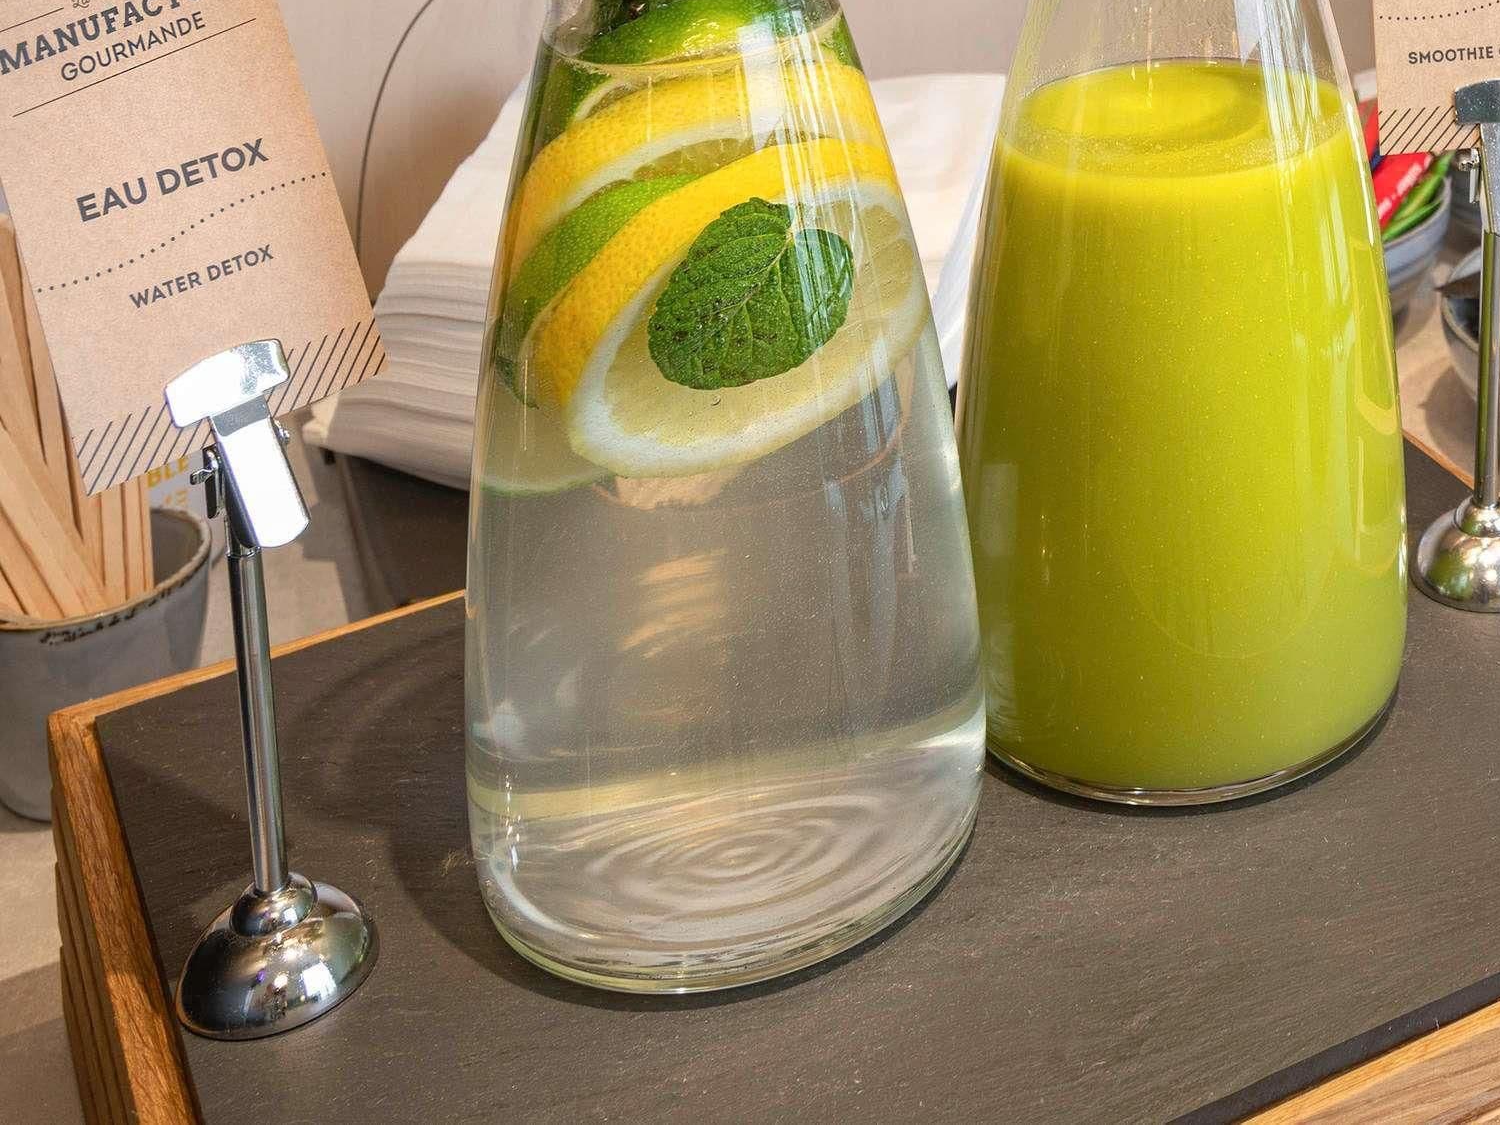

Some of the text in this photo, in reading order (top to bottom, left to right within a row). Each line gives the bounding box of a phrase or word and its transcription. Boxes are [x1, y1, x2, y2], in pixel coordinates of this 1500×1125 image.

[60, 11, 206, 83] GOURMANDE
[1408, 47, 1494, 65] SMOOTHIE
[76, 138, 270, 223] EAU DETOX
[130, 244, 274, 310] WATER DETOX
